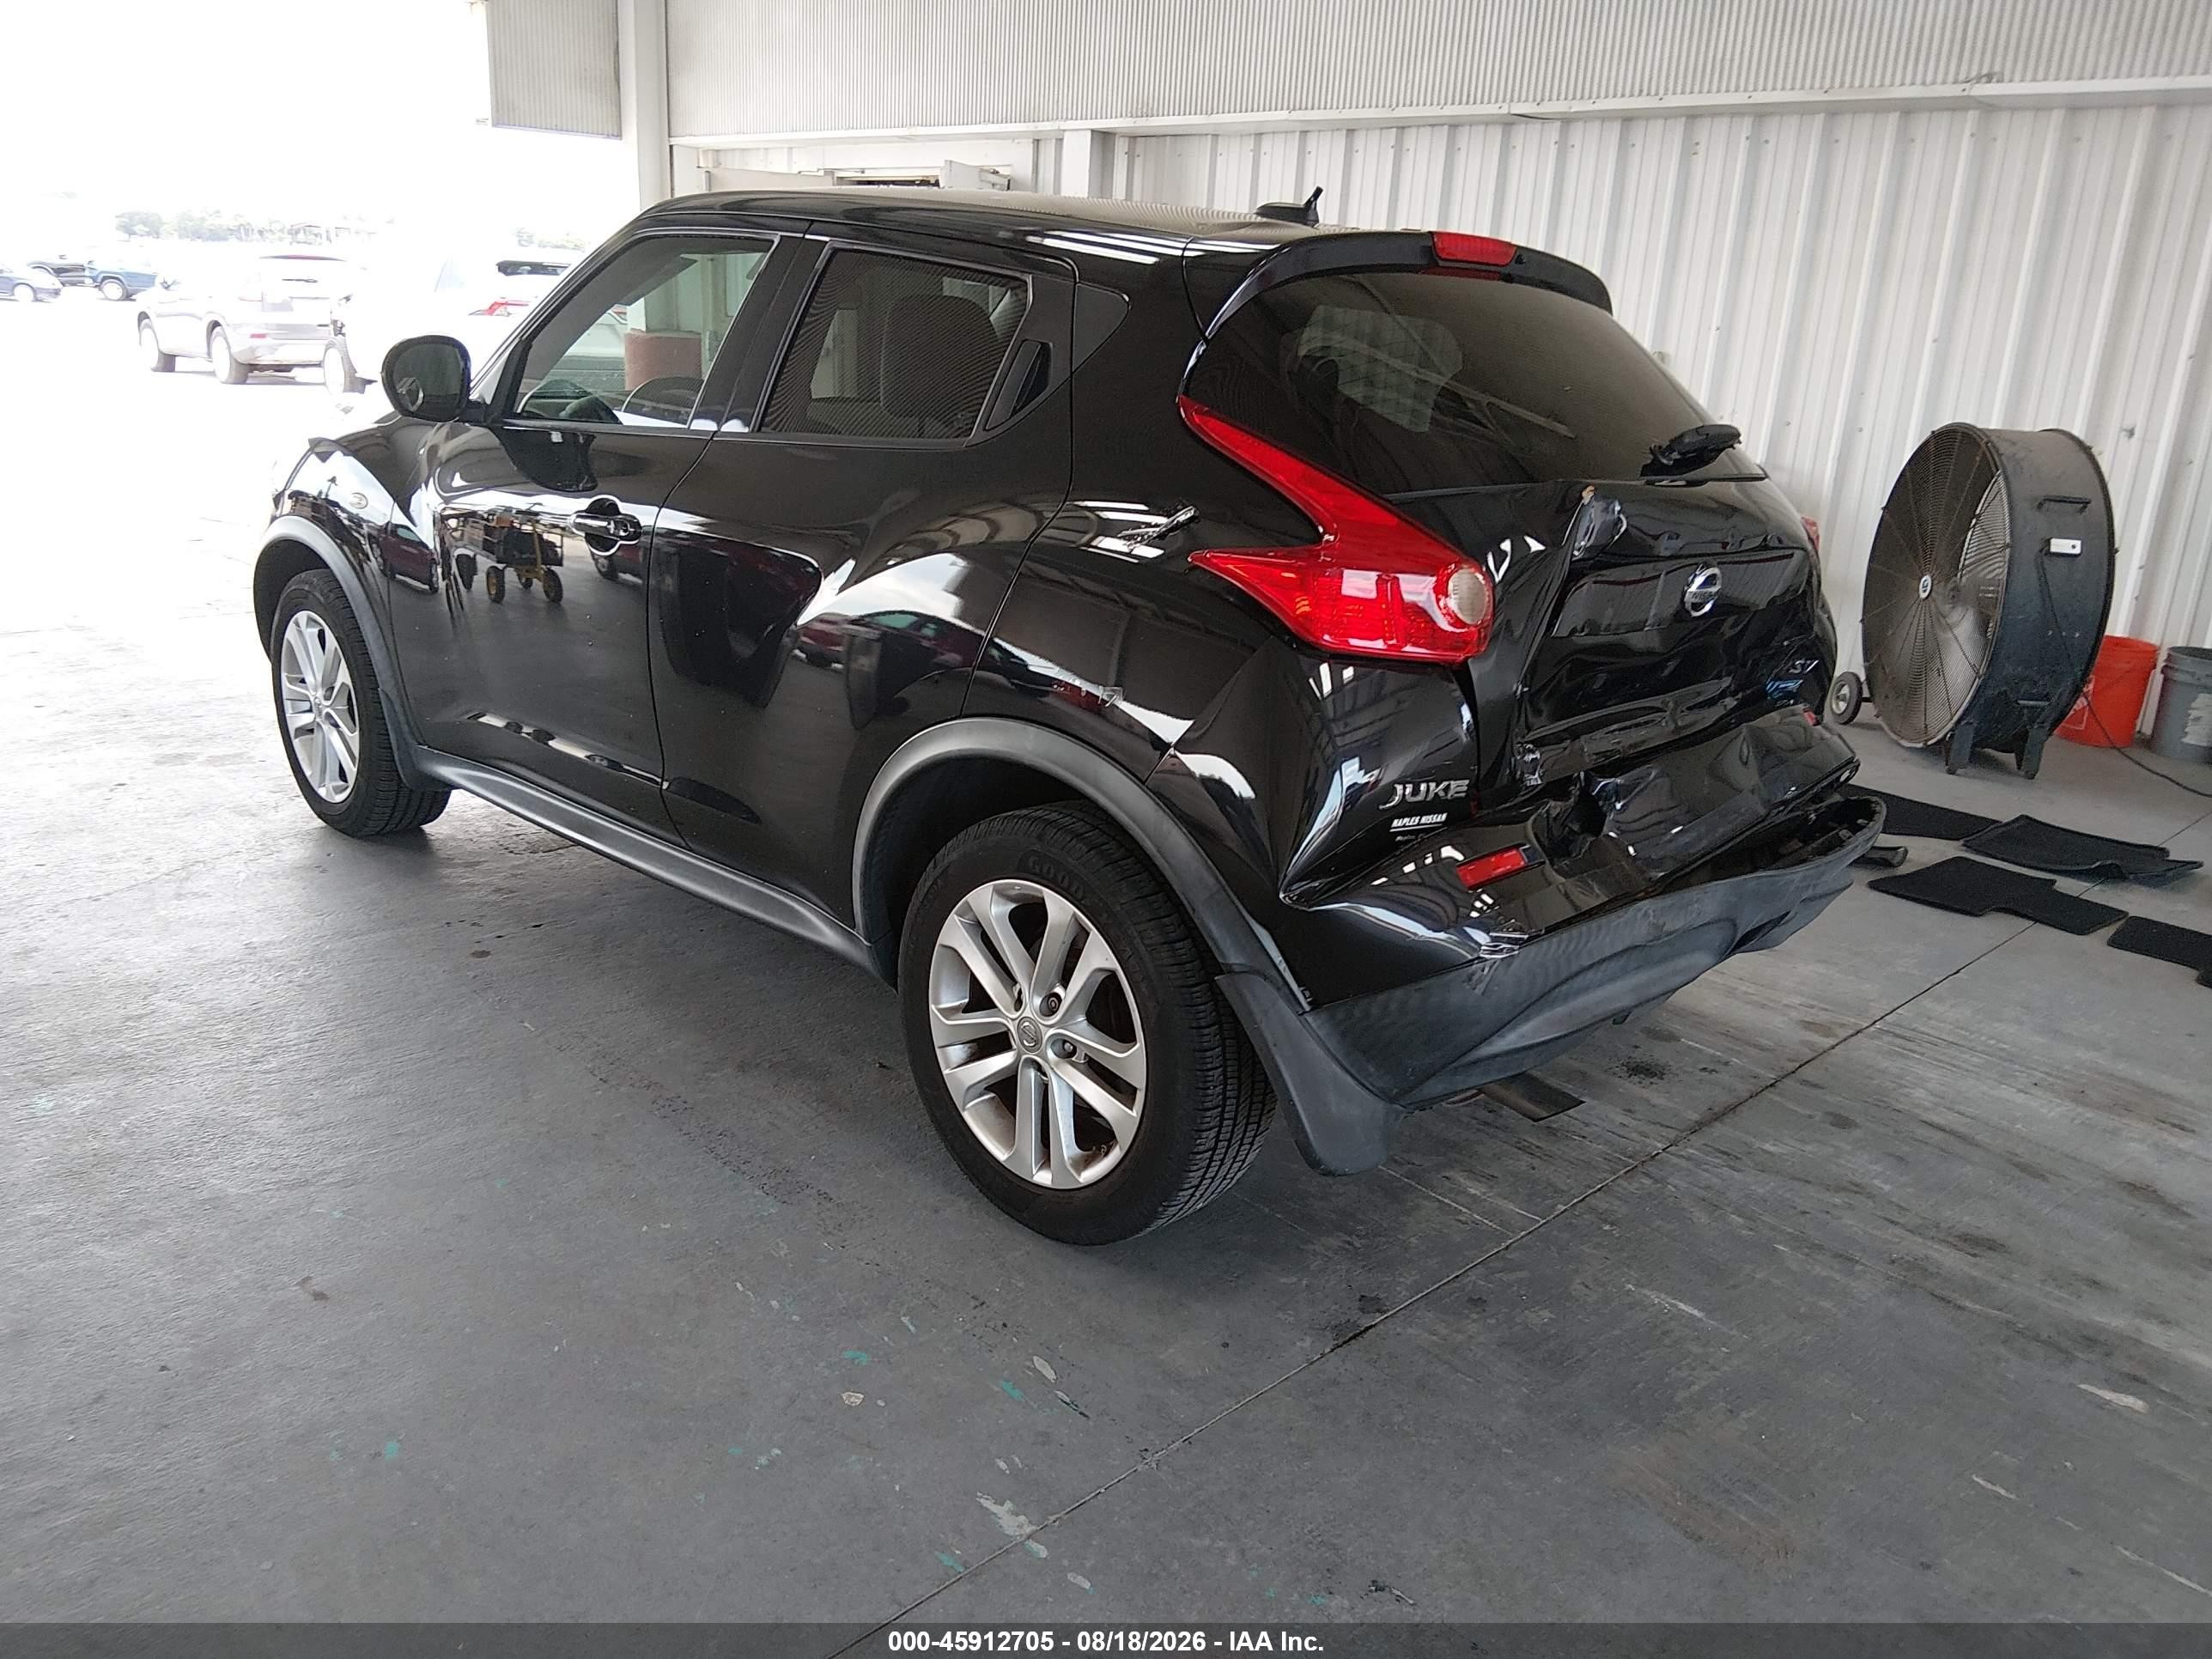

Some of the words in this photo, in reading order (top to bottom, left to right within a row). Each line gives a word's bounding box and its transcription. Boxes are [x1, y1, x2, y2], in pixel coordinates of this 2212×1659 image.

[1379, 780, 1470, 811] JUKE
[1391, 816, 1420, 828] NAPLES
[1420, 812, 1448, 824] NISSAN
